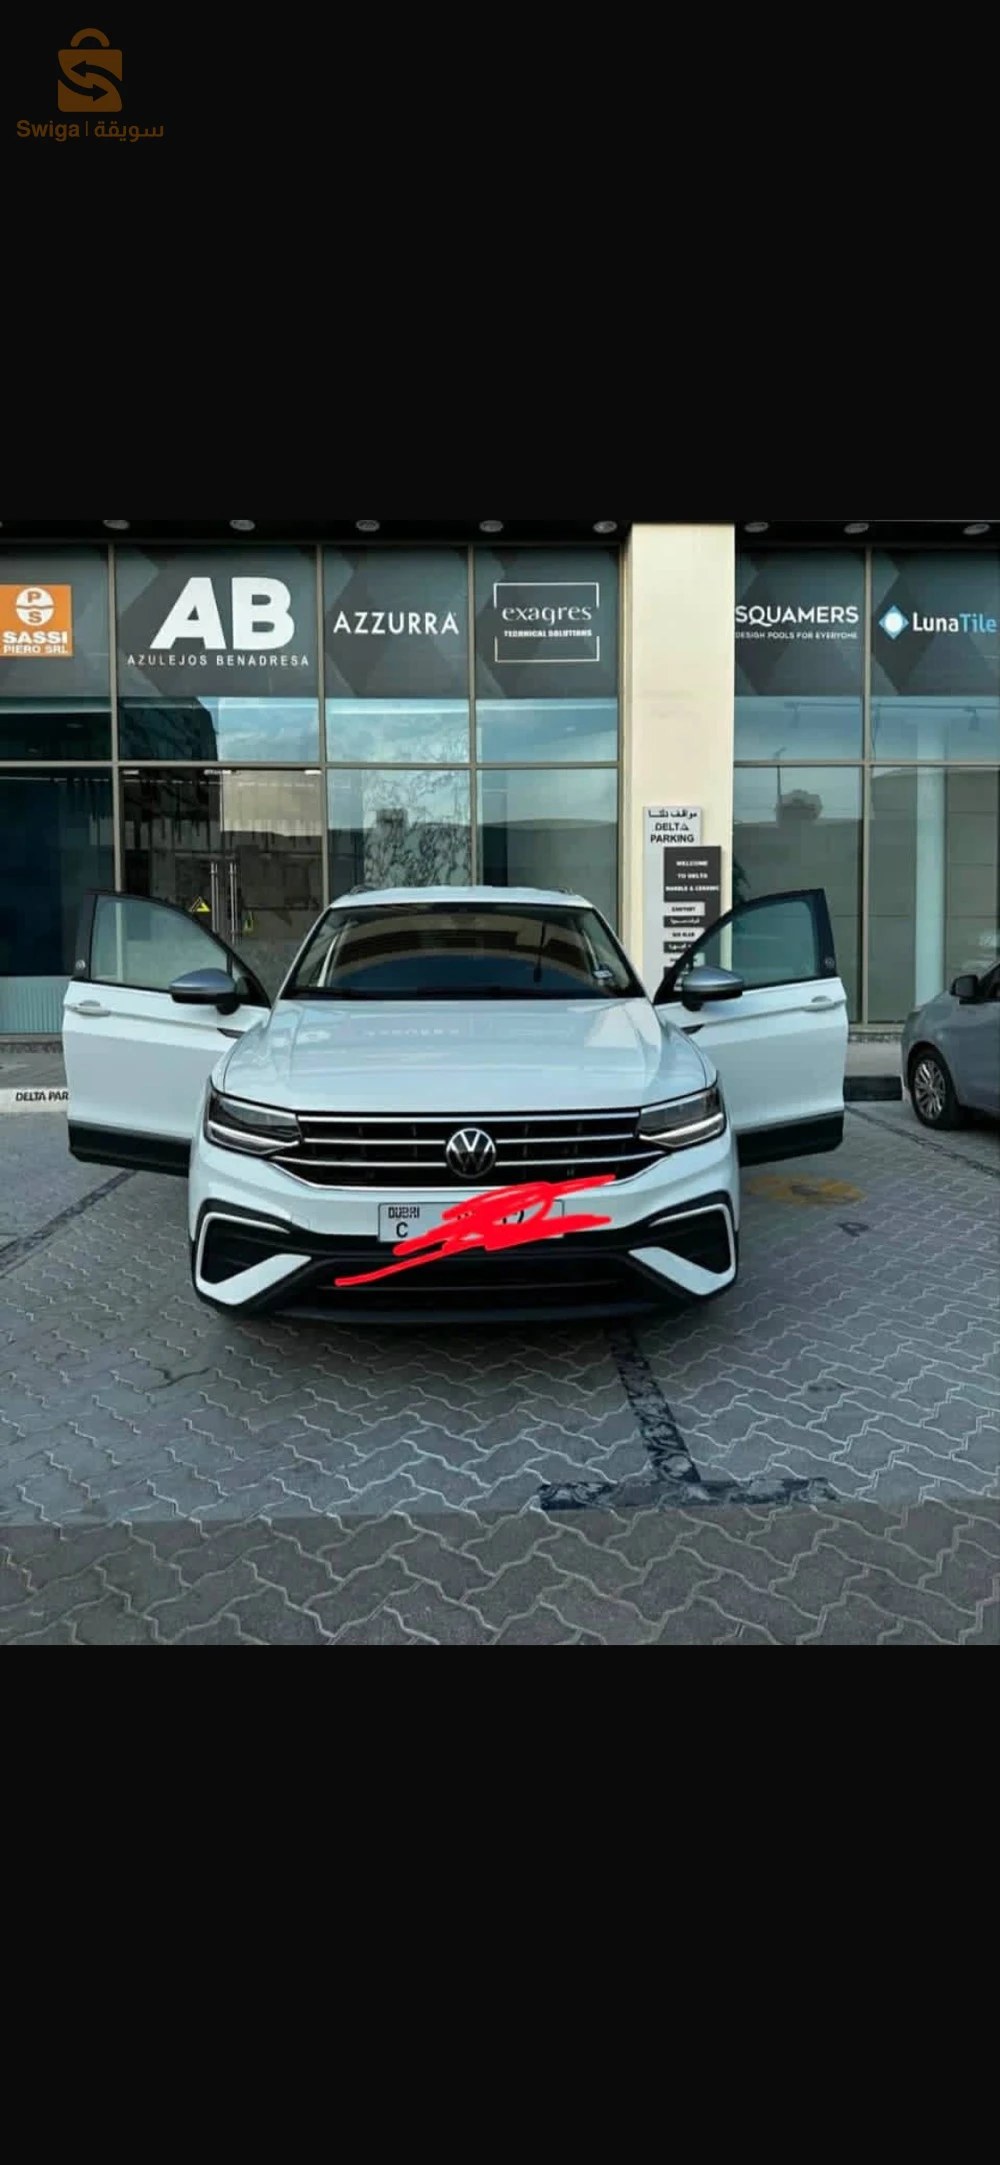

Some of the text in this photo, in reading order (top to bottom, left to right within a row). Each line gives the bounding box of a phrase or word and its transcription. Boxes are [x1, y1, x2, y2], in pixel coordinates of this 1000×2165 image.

[27, 591, 42, 603] P
[28, 611, 42, 623] S
[149, 576, 295, 650] AB
[502, 606, 592, 626] exagres
[735, 606, 859, 627] SQUAMERS
[333, 611, 459, 634] AZZURRA
[912, 612, 998, 633] LunaTile
[2, 631, 68, 644] SASSI
[548, 629, 592, 637] SOLUTIONS
[767, 631, 794, 639] POOLS
[796, 631, 813, 639] FOR
[815, 631, 857, 639] EVERYONE
[3, 645, 68, 653] PIERO SRL
[127, 655, 309, 666] AZULEJOS BENADRESA
[650, 834, 695, 843] PARKING
[15, 1091, 46, 1102] DELTA
[388, 1206, 420, 1219] DUBAI
[396, 1221, 408, 1238] C
